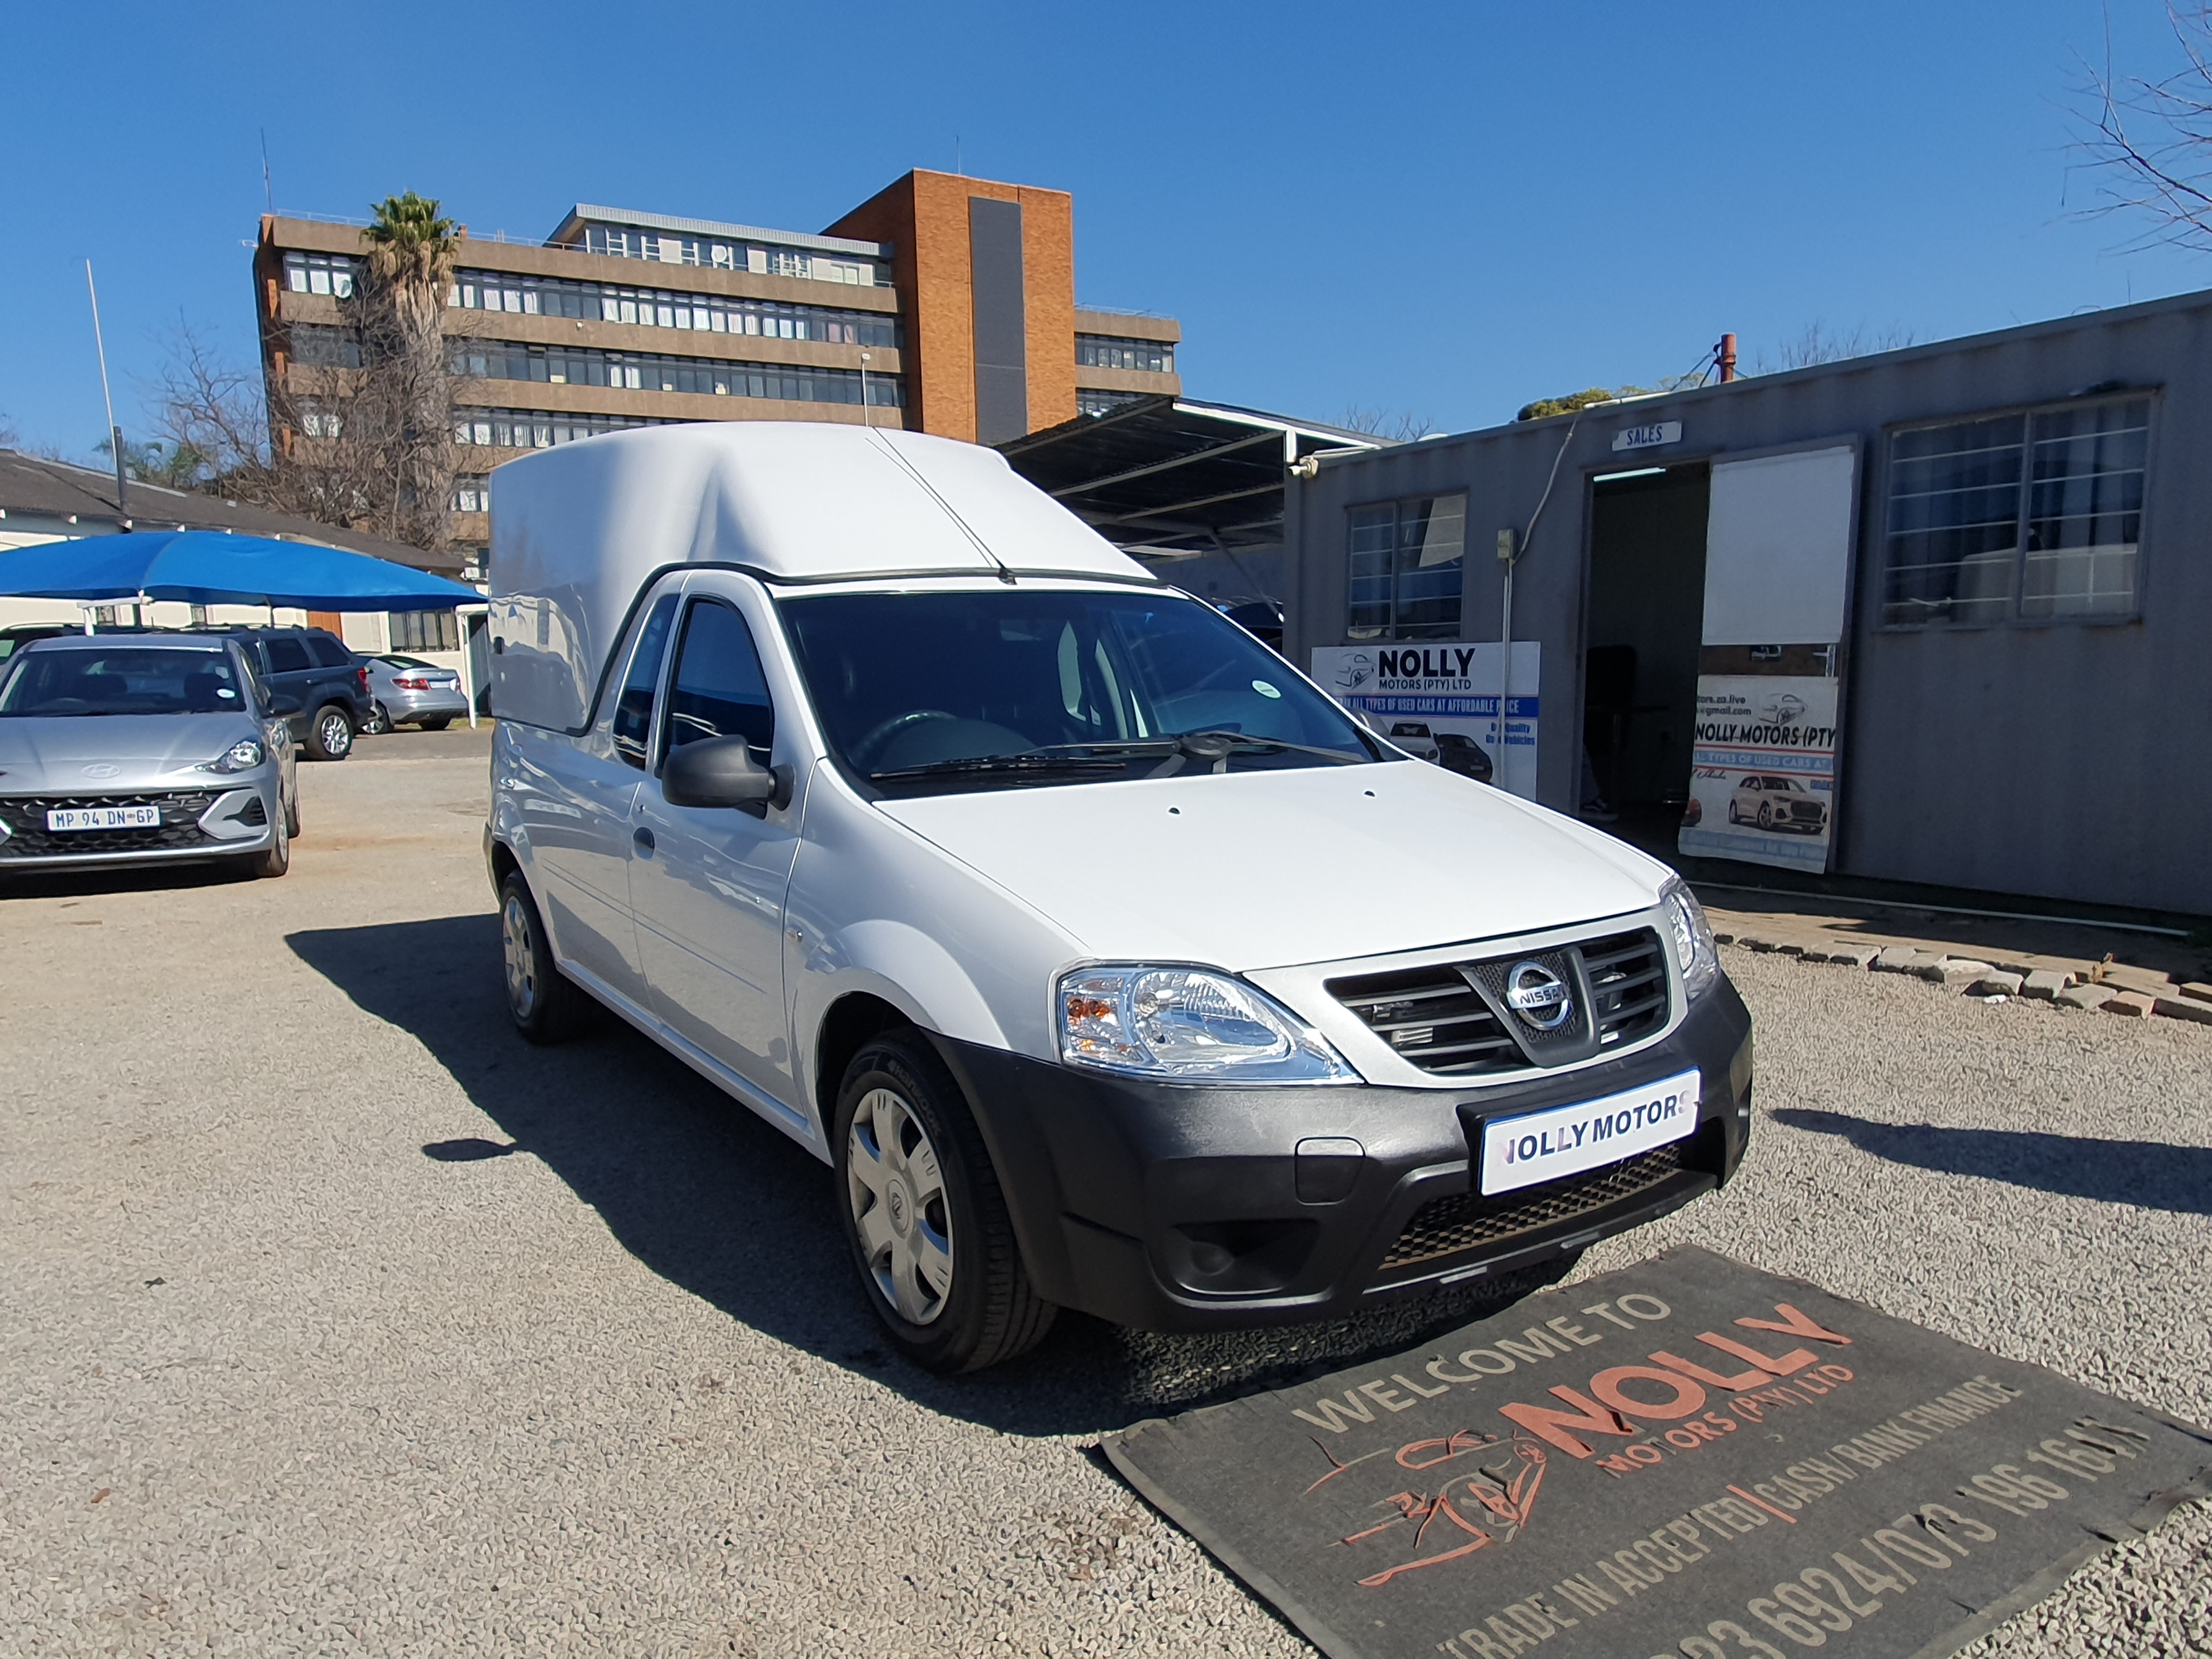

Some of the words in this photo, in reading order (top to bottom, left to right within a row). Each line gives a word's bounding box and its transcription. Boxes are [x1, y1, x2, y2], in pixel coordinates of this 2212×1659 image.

[1627, 425, 1662, 445] SALES
[1378, 648, 1476, 677] NOLLY
[1379, 679, 1421, 690] MOTORS
[1424, 679, 1449, 691] (PTY)
[1452, 679, 1472, 690] LTD
[1366, 698, 1386, 711] TYPES
[1387, 698, 1396, 711] OF
[1397, 698, 1415, 711] USED
[1417, 698, 1435, 712] CARS
[1436, 698, 1446, 712] AT
[1448, 699, 1494, 713] AFFORDABLE
[1496, 699, 1519, 714] PICE
[1695, 723, 1737, 742] NOLLY
[1740, 725, 1800, 745] MOTORS
[1803, 726, 1836, 747] (PTY
[1707, 752, 1736, 764] TYPES
[1739, 753, 1752, 764] OF
[1754, 754, 1780, 766] USED
[1782, 756, 1811, 768] CARS
[55, 812, 74, 828] MP
[82, 811, 100, 826] 94
[107, 810, 126, 825] DN
[136, 808, 154, 824] GP
[1496, 1121, 1588, 1166] NOLLY
[1592, 1090, 1691, 1142] MOTORS
[1292, 1316, 1603, 1433] WELCOME
[1580, 1293, 1671, 1330] TO
[1498, 1302, 1852, 1459] NOLLY
[1595, 1412, 1738, 1479] MOTORS
[1794, 1364, 1854, 1394] LTD
[1957, 1463, 2070, 1517] 196
[1435, 1592, 1579, 1659] TRADE
[1552, 1573, 1619, 1616] IN
[1595, 1497, 1769, 1597] ACCEPTED
[1899, 1375, 2024, 1434] FINANCE
